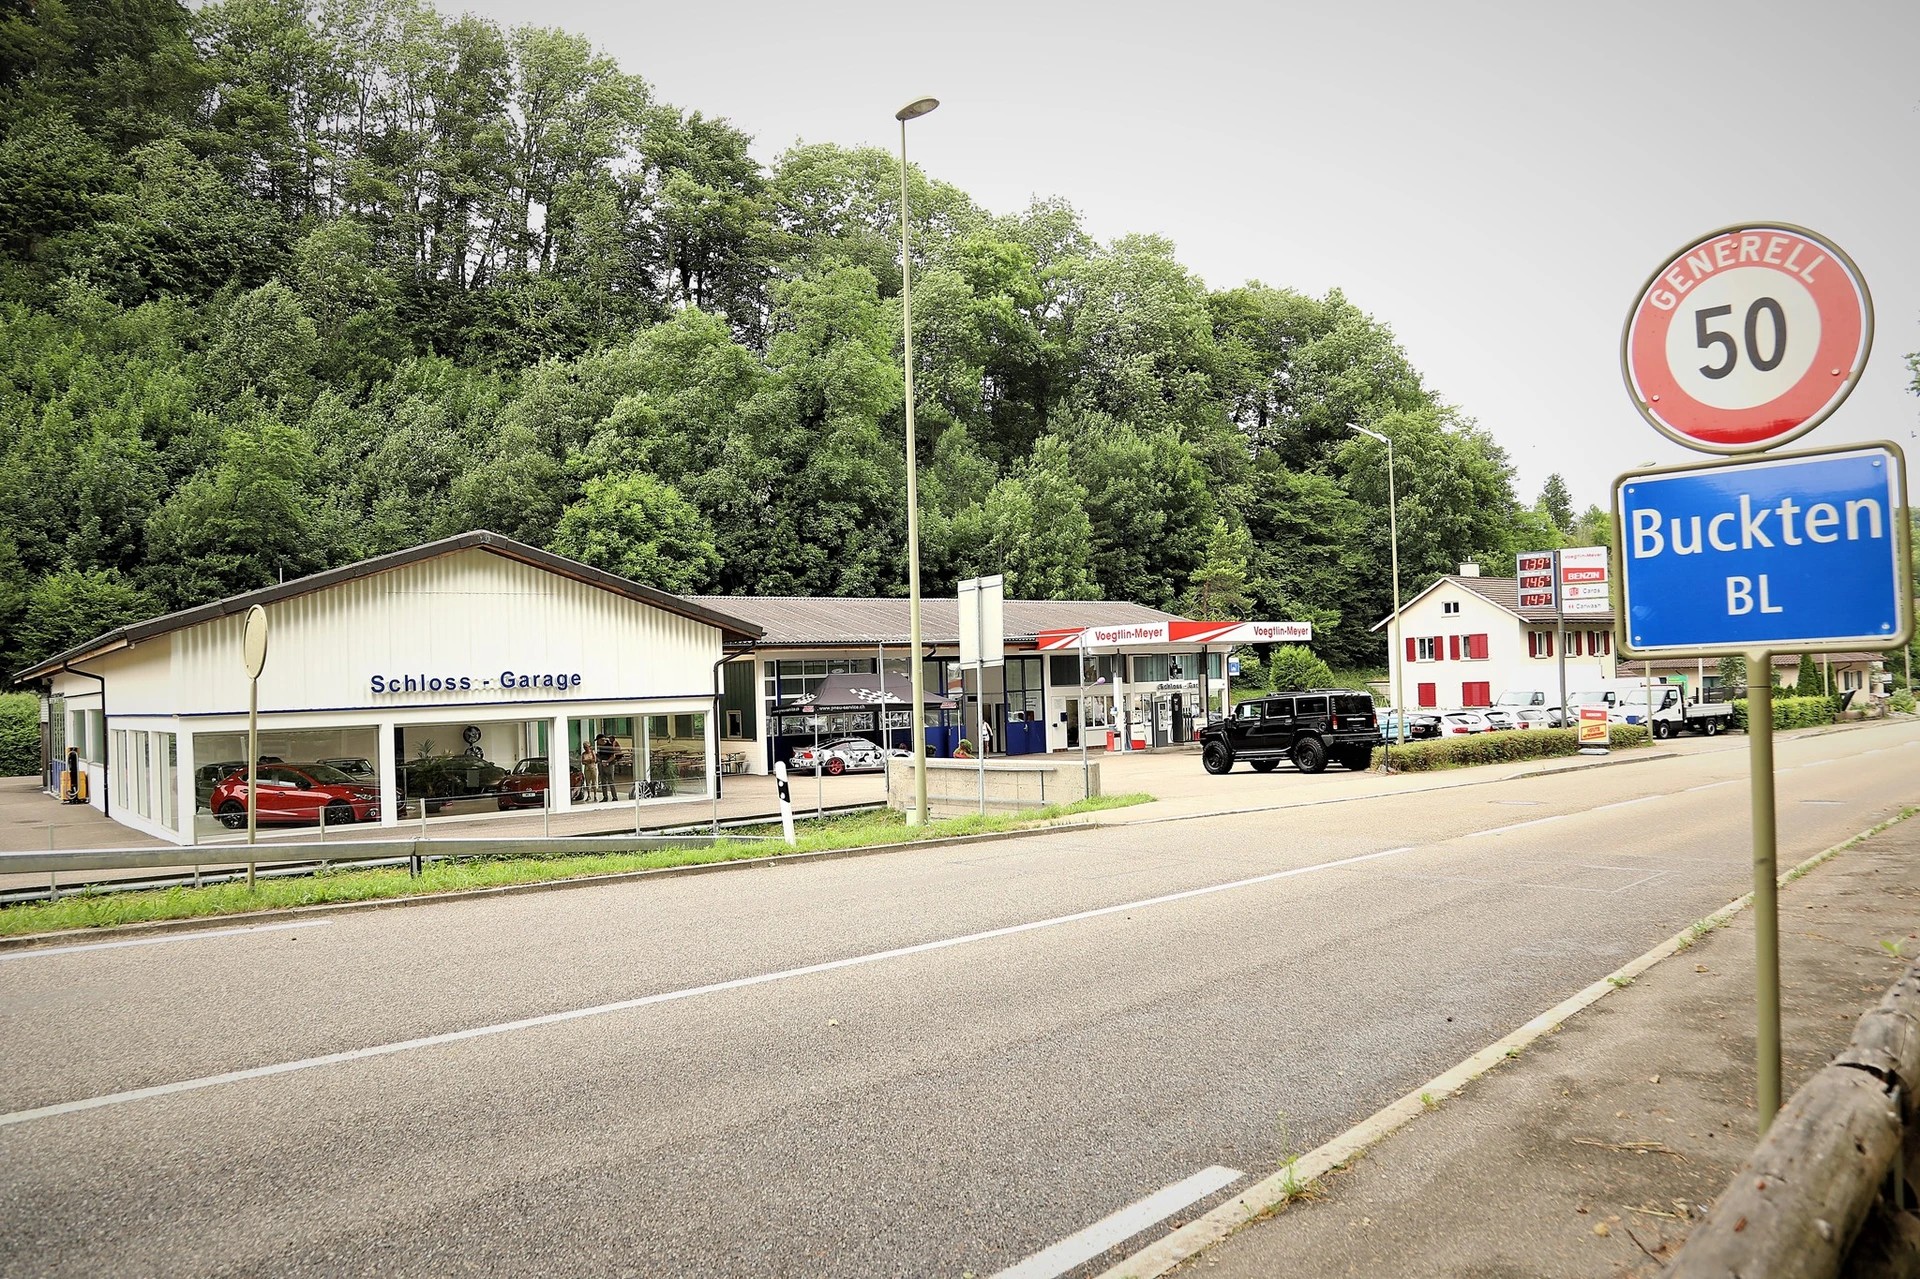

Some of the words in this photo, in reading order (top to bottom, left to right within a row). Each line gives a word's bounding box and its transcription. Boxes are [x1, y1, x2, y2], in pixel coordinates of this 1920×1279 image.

[1651, 235, 1825, 311] GENERELL
[1695, 296, 1786, 379] 50
[1632, 494, 1882, 559] Buckten
[1567, 571, 1600, 580] BENZIN
[1726, 574, 1783, 616] BL
[1095, 628, 1163, 643] Voegtlin-Meyer
[1253, 626, 1309, 639] Voegtlin-Meyer
[370, 674, 472, 694] Schloss
[500, 671, 582, 691] Garage
